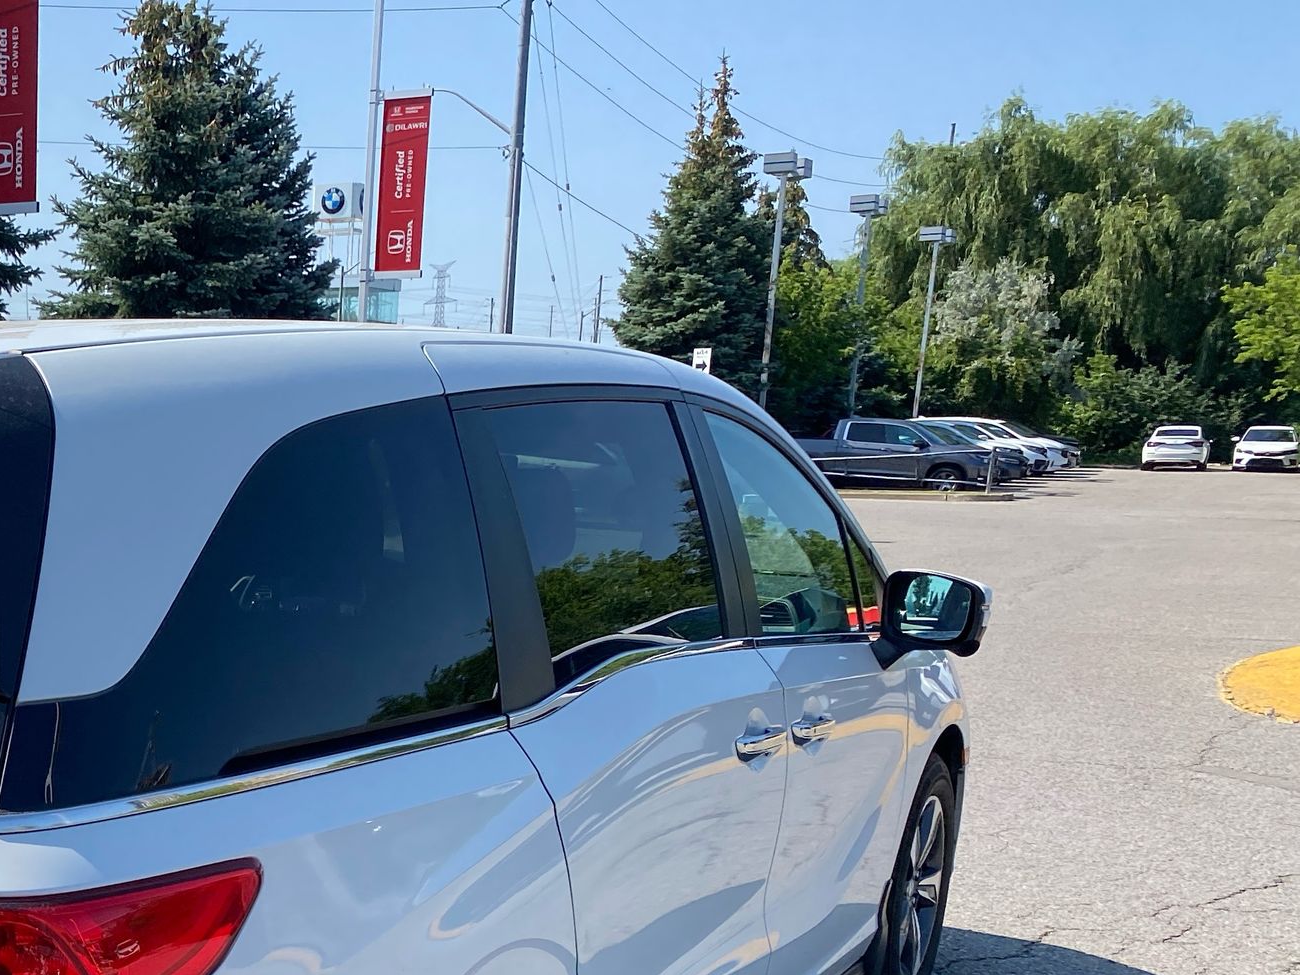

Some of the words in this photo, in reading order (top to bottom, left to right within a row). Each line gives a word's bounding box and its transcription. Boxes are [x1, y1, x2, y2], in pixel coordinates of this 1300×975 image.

[15, 127, 23, 188] HONDA
[395, 151, 405, 199] Certified
[405, 149, 413, 198] PRE-OWNED
